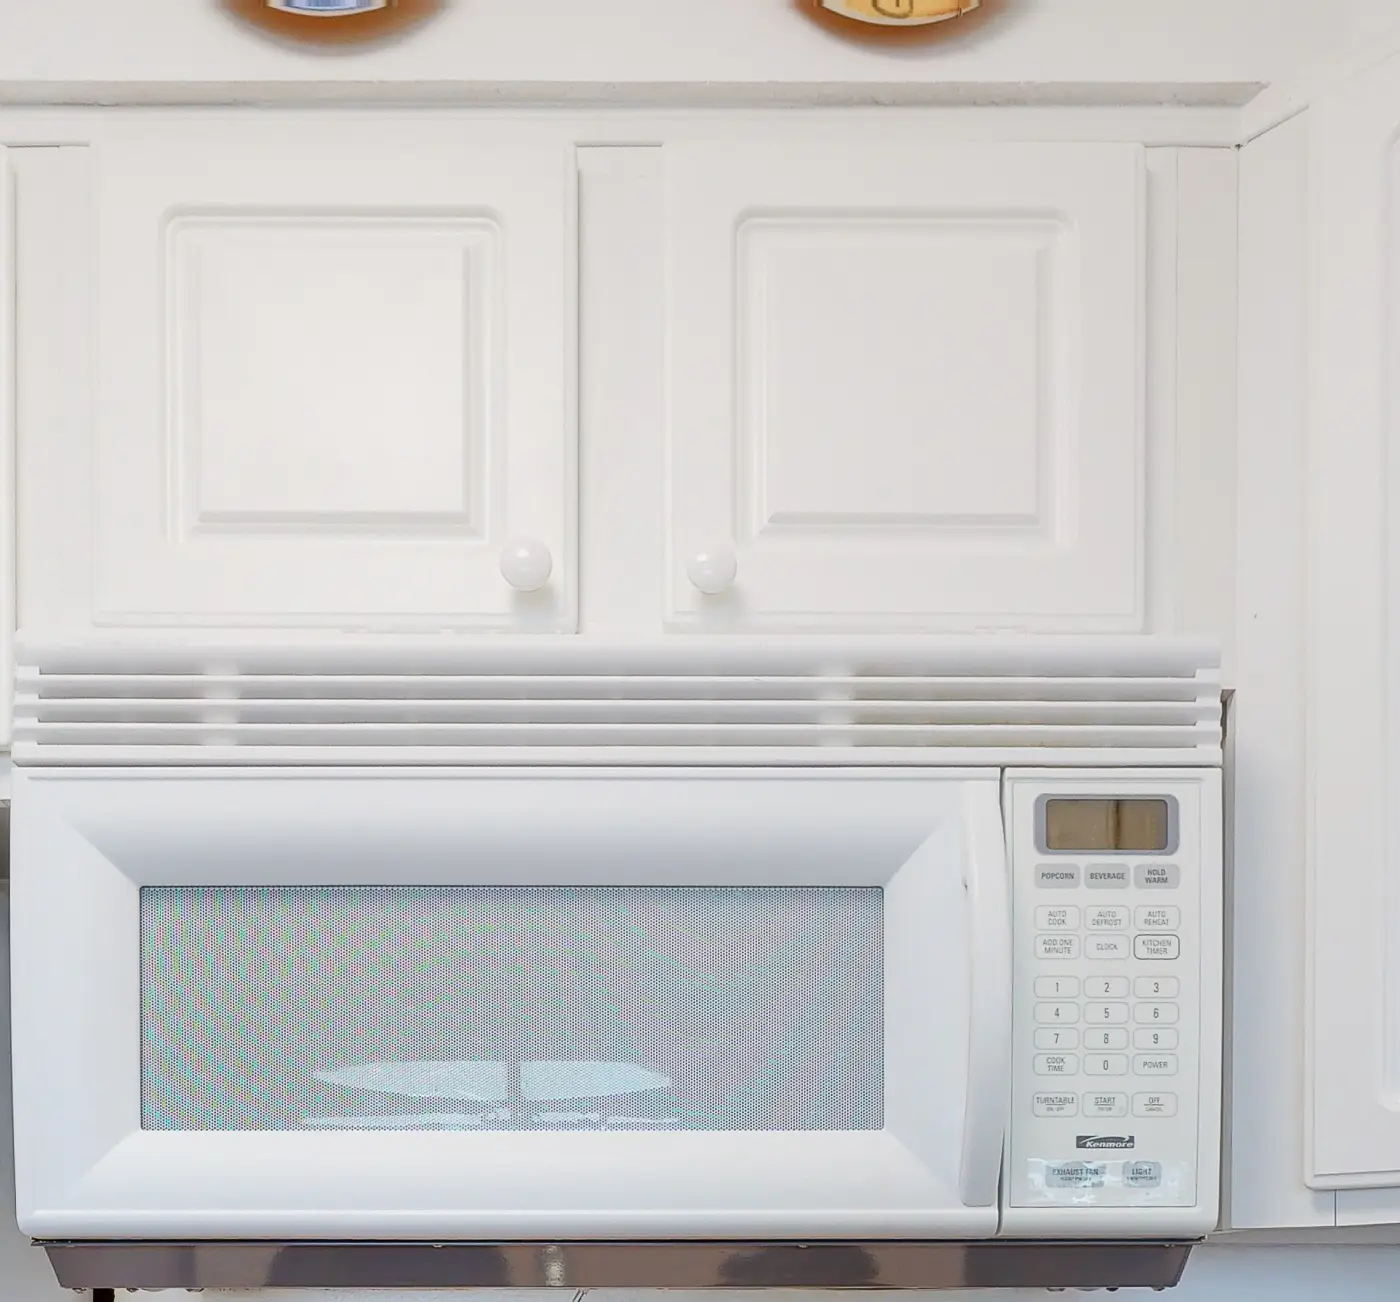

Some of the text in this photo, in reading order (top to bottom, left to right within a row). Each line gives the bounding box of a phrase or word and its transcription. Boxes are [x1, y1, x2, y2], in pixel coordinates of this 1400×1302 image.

[1041, 872, 1075, 880] POPCORN
[1089, 872, 1126, 880] BEVERAGE
[1048, 910, 1067, 918] AUTO
[1048, 918, 1067, 926] COOK
[1144, 918, 1169, 926] REHEAT
[1147, 947, 1168, 955] TIMER
[1055, 982, 1059, 992] 1
[1104, 982, 1109, 993] 2
[1153, 982, 1159, 993] 3
[1054, 1008, 1060, 1017] 4
[1104, 1008, 1109, 1018] 5
[1153, 1008, 1159, 1018] 6
[1053, 1033, 1059, 1043] 7
[1103, 1033, 1109, 1044] 8
[1153, 1033, 1158, 1044] 9
[1103, 1060, 1108, 1070] 0
[1143, 1061, 1168, 1069] POWER
[1052, 1168, 1099, 1176] EXHAUST FAN
